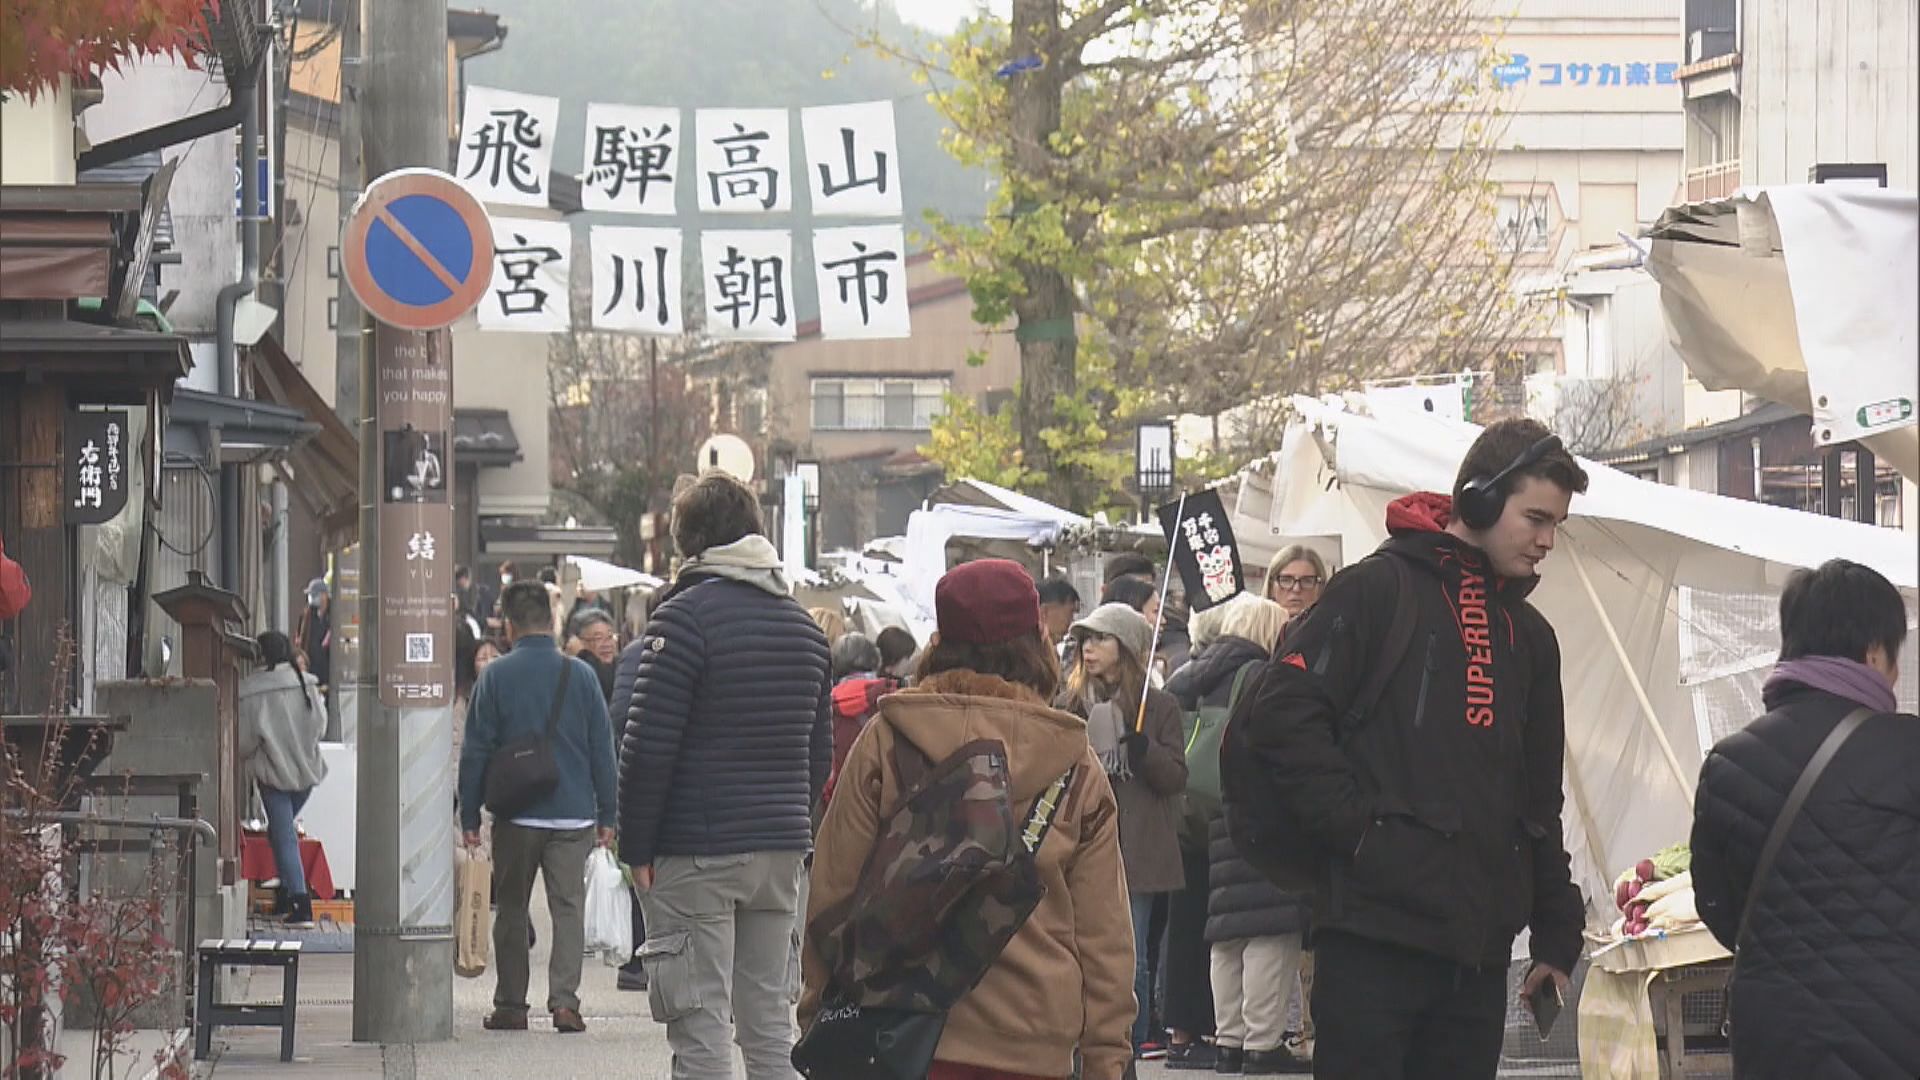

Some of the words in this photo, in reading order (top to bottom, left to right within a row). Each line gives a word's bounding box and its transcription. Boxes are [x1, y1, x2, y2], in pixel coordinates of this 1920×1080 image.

[464, 108, 888, 210] 飛騨高山
[493, 233, 898, 331] 宮川朝市
[382, 367, 408, 380] that
[383, 390, 408, 404] you
[412, 387, 447, 405] happy
[405, 530, 436, 561] 結
[1459, 568, 1495, 727] SUPERDRY
[392, 683, 444, 698] 下三之町
